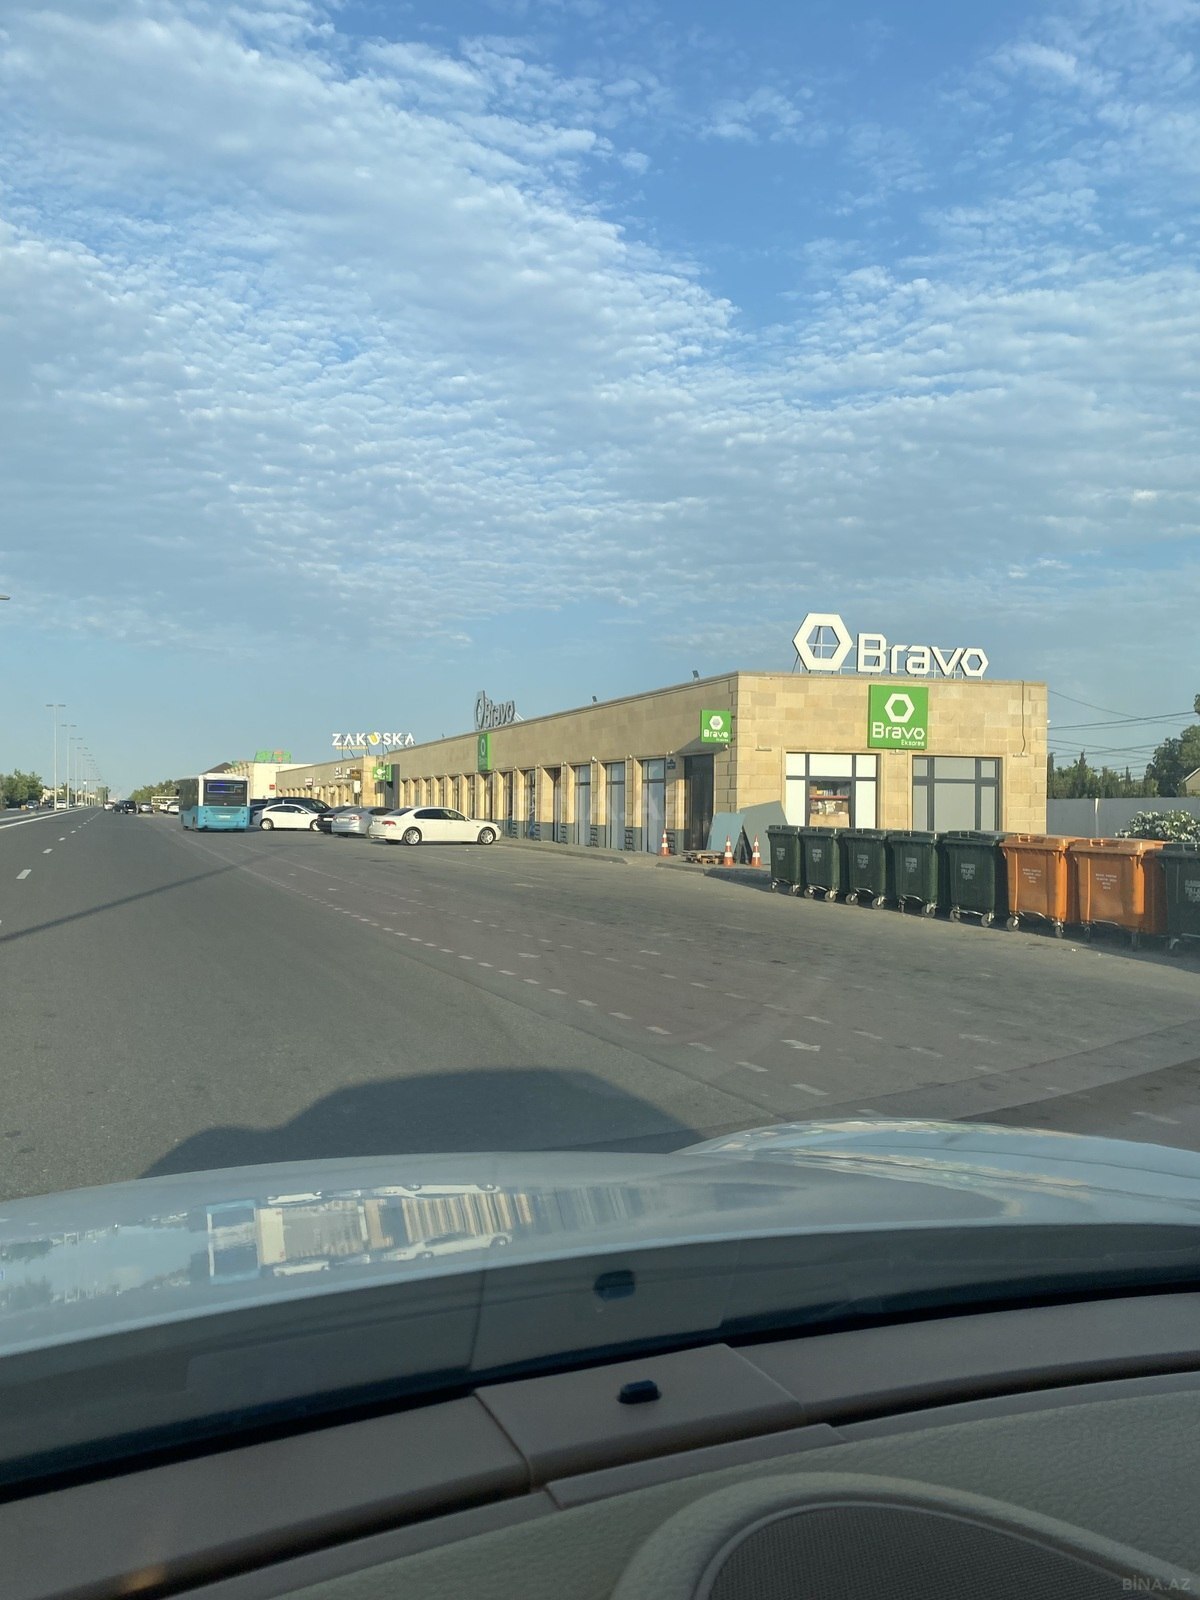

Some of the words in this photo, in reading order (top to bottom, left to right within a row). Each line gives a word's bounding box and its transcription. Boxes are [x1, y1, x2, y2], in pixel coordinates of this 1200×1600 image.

[857, 632, 989, 677] Bravo
[703, 729, 729, 738] Bravo
[872, 721, 925, 740] Bravo
